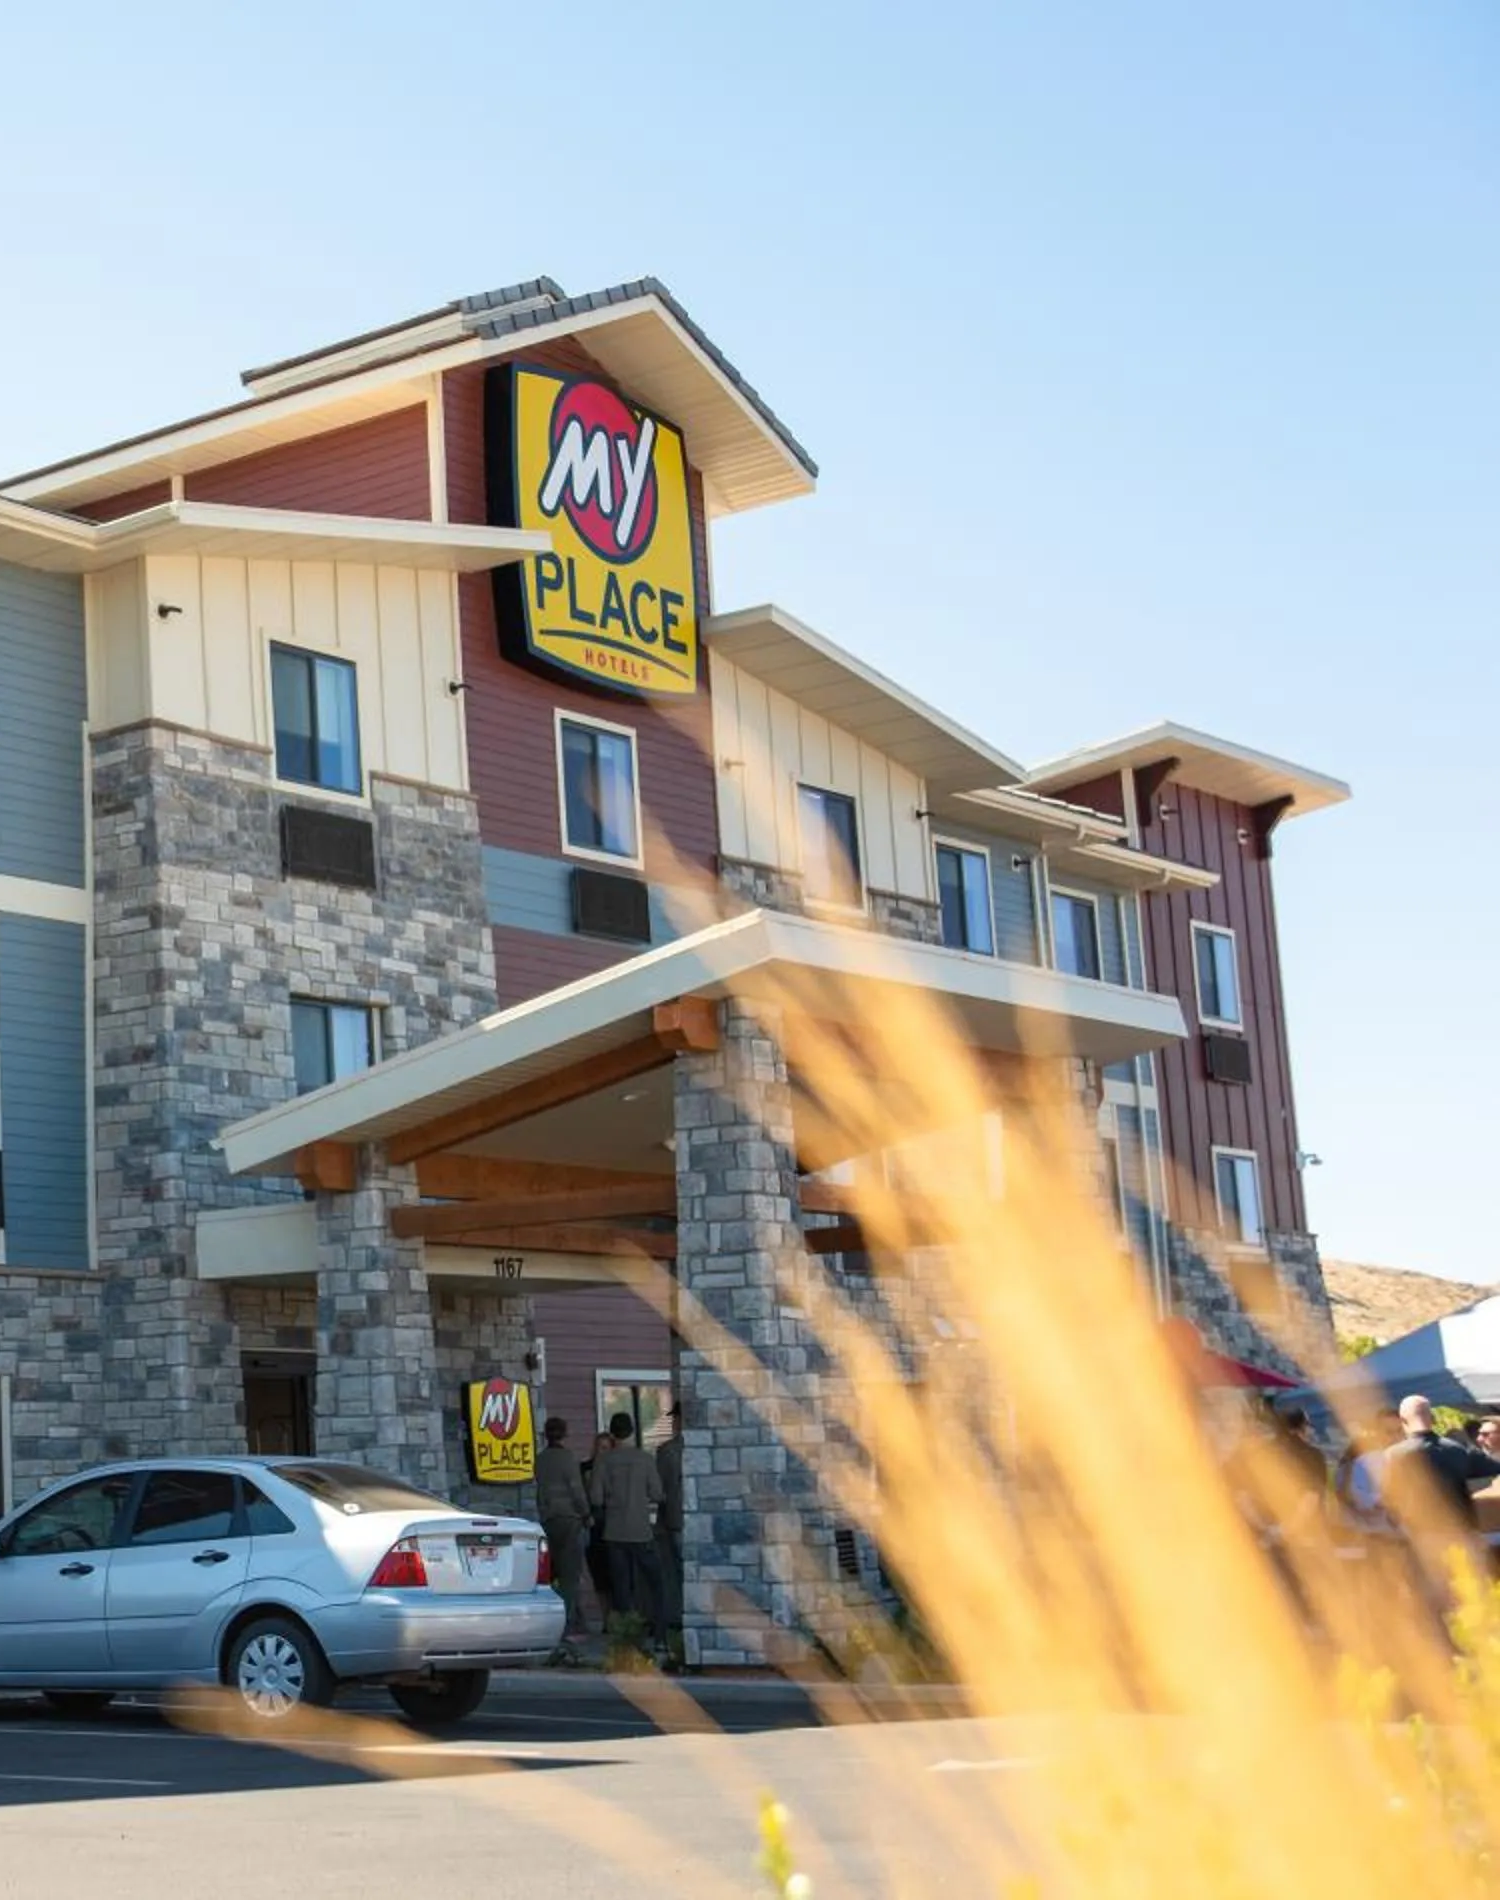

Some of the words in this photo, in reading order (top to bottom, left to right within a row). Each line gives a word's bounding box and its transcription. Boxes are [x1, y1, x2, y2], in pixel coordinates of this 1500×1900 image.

[535, 552, 688, 654] PLACE
[585, 647, 650, 681] HOTELS
[493, 1257, 524, 1278] 1167
[478, 1443, 531, 1465] PLACE
